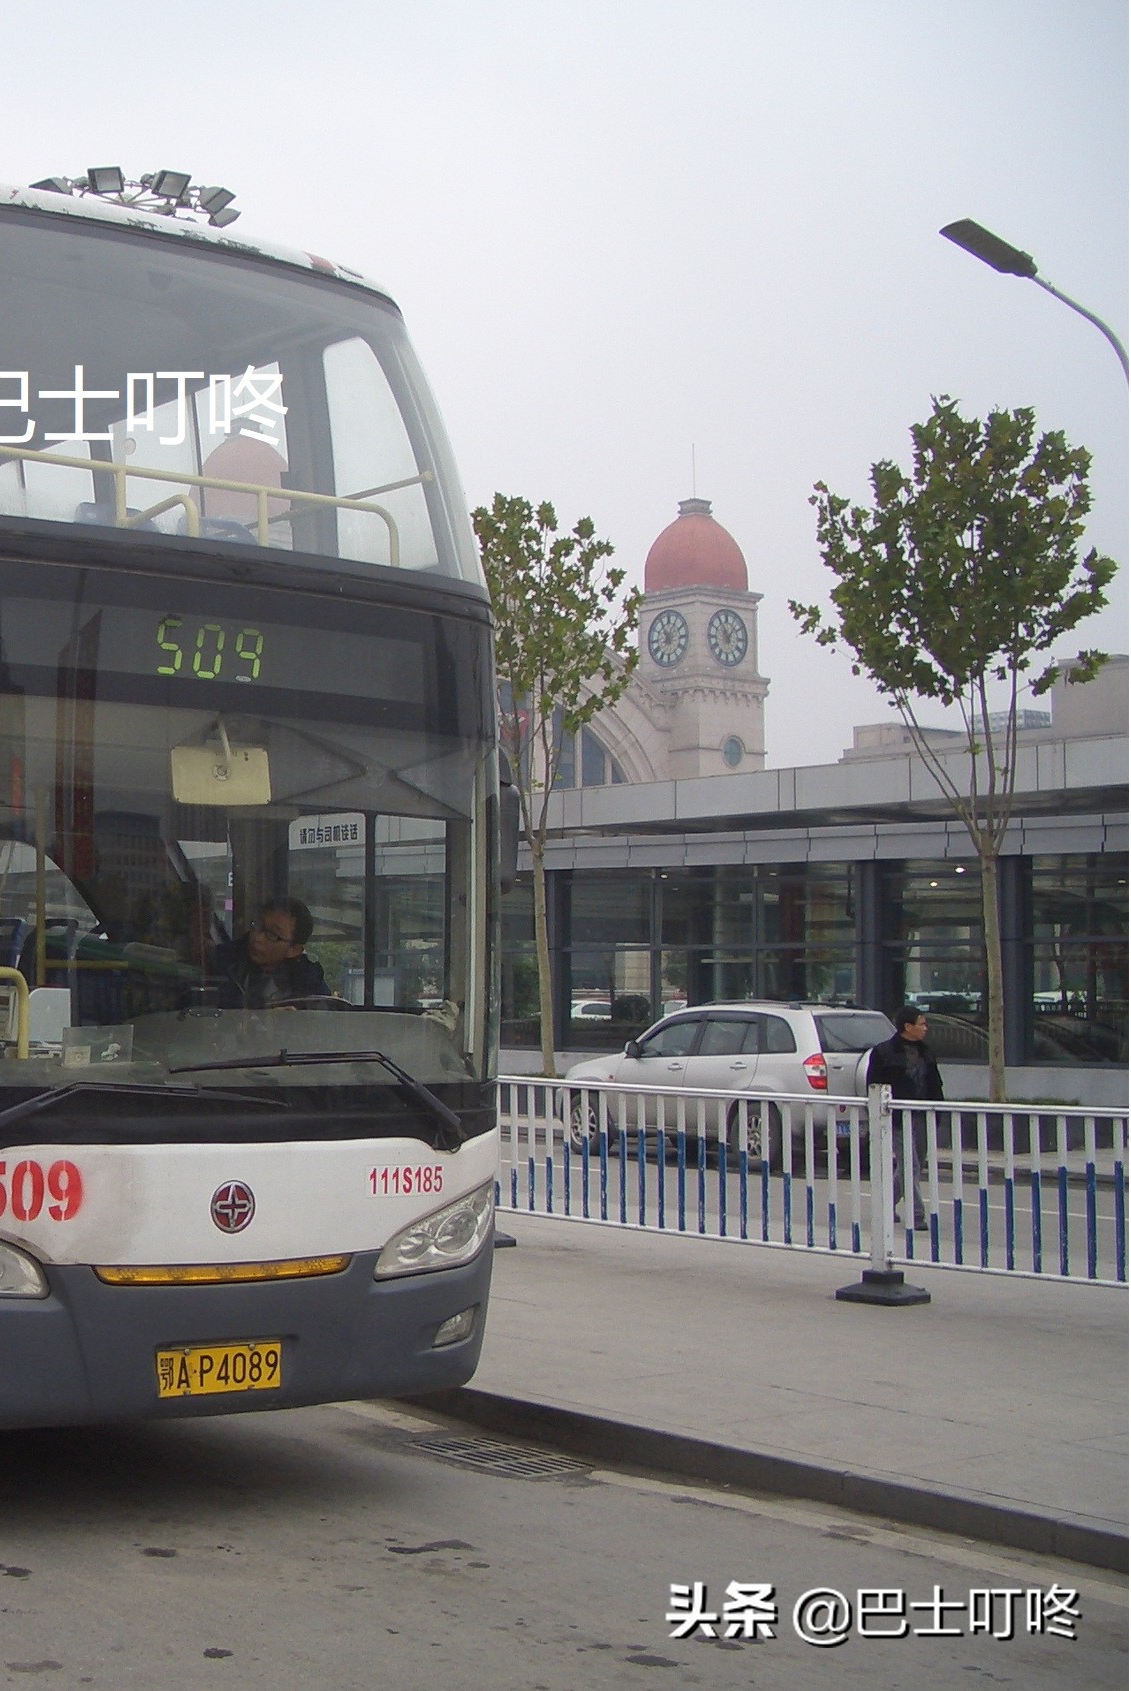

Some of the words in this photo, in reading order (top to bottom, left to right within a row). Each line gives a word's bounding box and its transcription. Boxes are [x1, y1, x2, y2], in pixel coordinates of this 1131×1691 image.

[156, 619, 264, 680] 509
[299, 823, 359, 845] 请勿与司机谈话
[369, 1166, 443, 1195] 111S185
